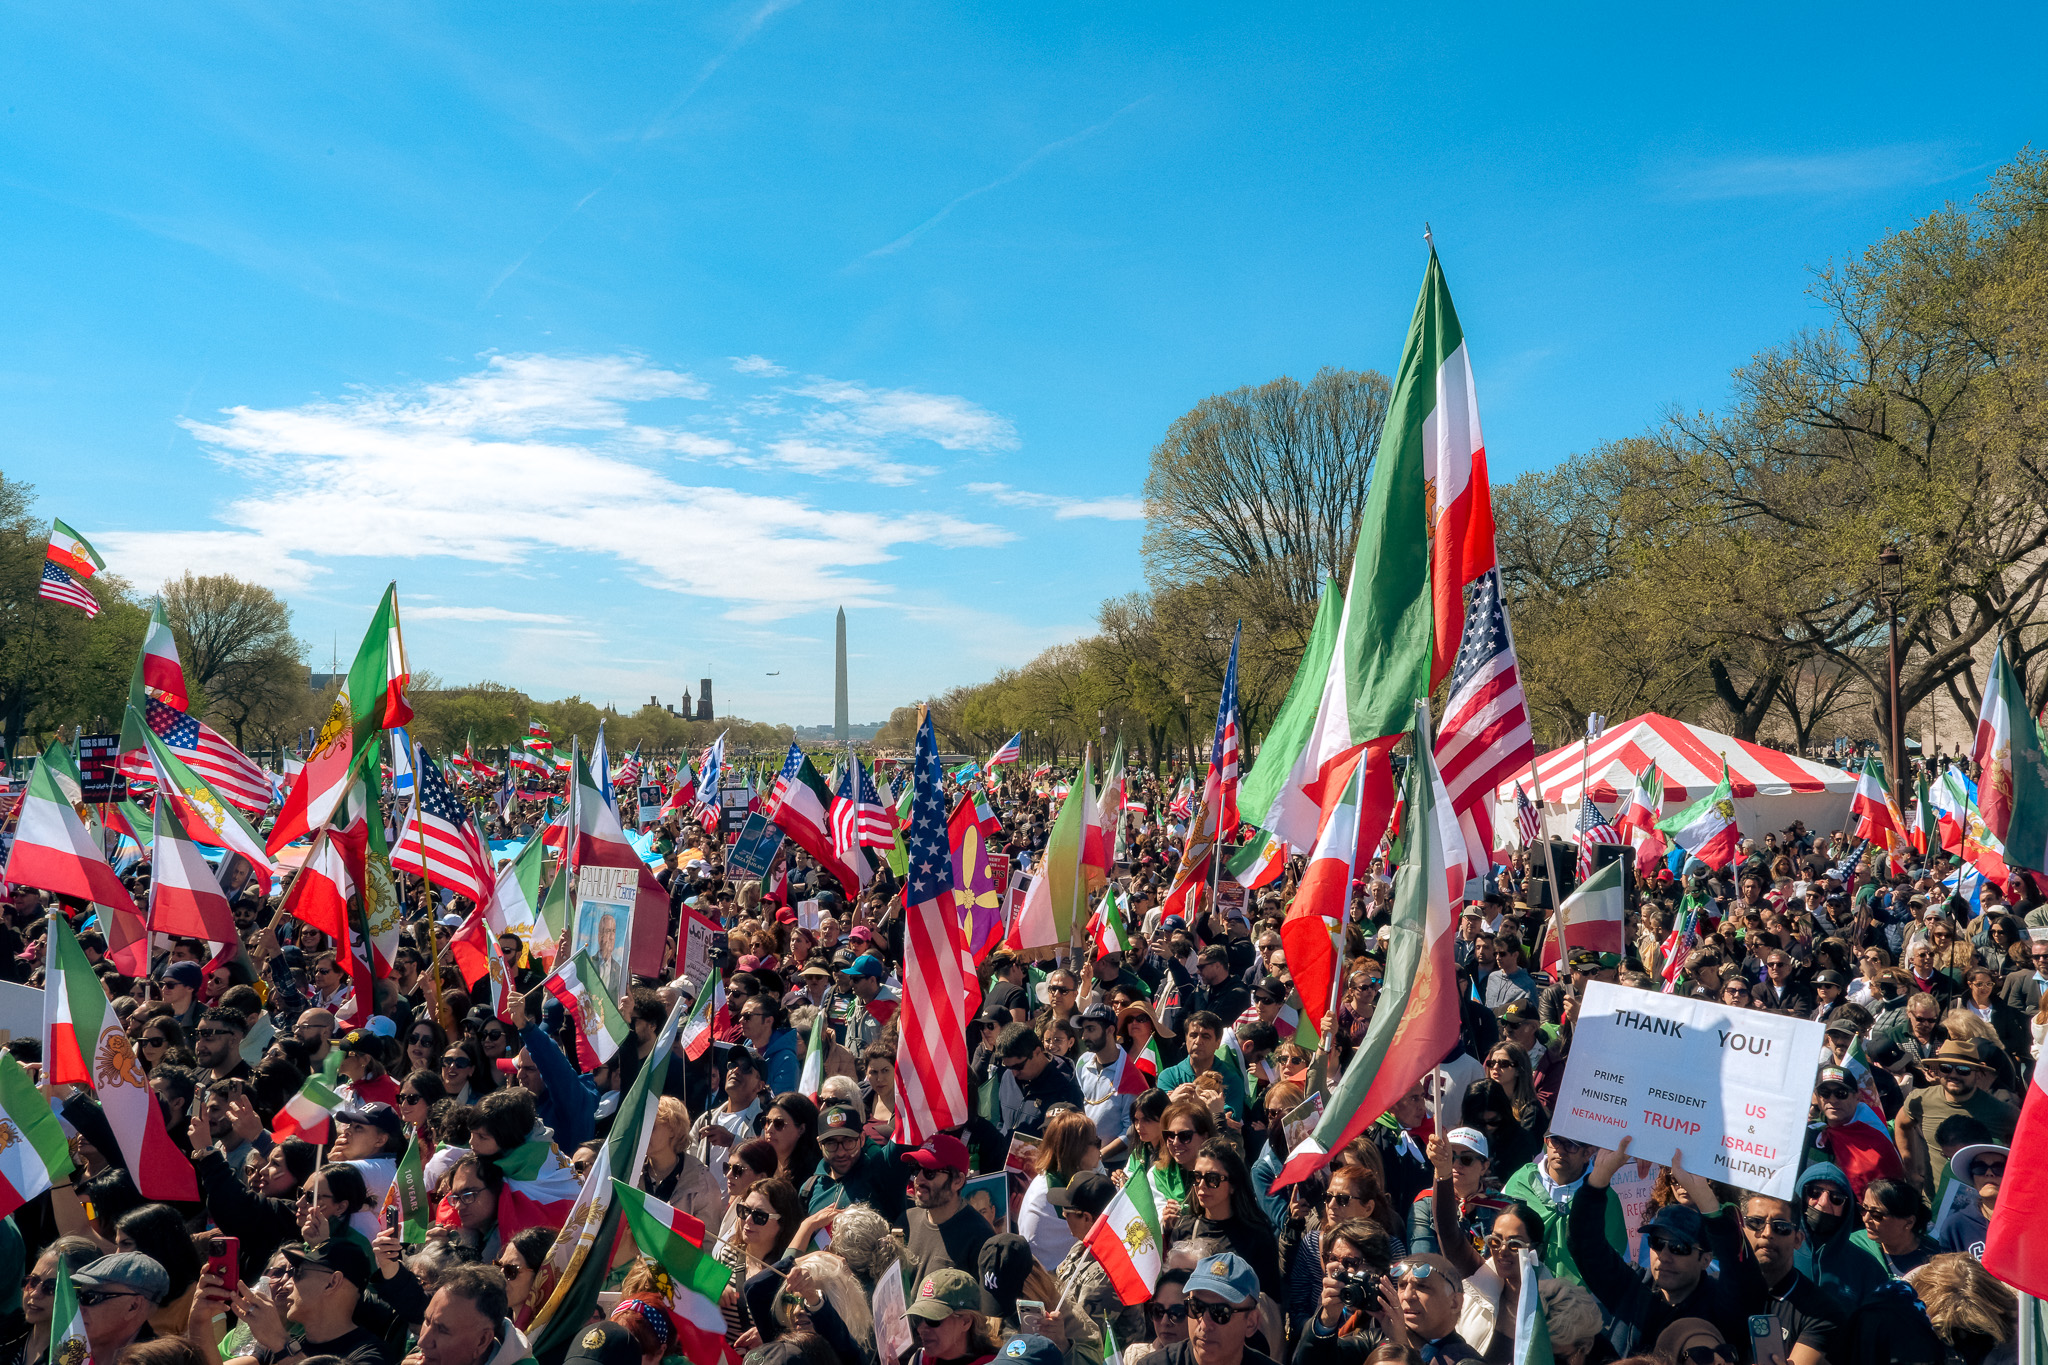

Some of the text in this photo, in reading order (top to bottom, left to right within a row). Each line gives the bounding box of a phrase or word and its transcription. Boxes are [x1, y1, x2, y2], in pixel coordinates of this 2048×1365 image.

[80, 738, 113, 748] THIS IS NOT A
[80, 748, 92, 757] WAR
[82, 772, 92, 780] FOR
[734, 854, 746, 862] REZA
[1614, 1009, 1772, 1057] THANK YOU!
[1594, 1070, 1625, 1084] PRIME
[1582, 1088, 1628, 1106] MINISTER
[1648, 1088, 1707, 1109] PRESIDENT
[359, 1102, 378, 1113] BI
[1745, 1104, 1767, 1119] US
[1572, 1107, 1628, 1129] NETANYAHU
[1643, 1110, 1701, 1136] TRUMP
[1747, 1125, 1756, 1135] &
[1720, 1135, 1776, 1160] ISRAELI
[1714, 1154, 1776, 1179] MILITARY
[404, 1169, 418, 1211] 100 YEARS
[984, 1271, 998, 1289] NY
